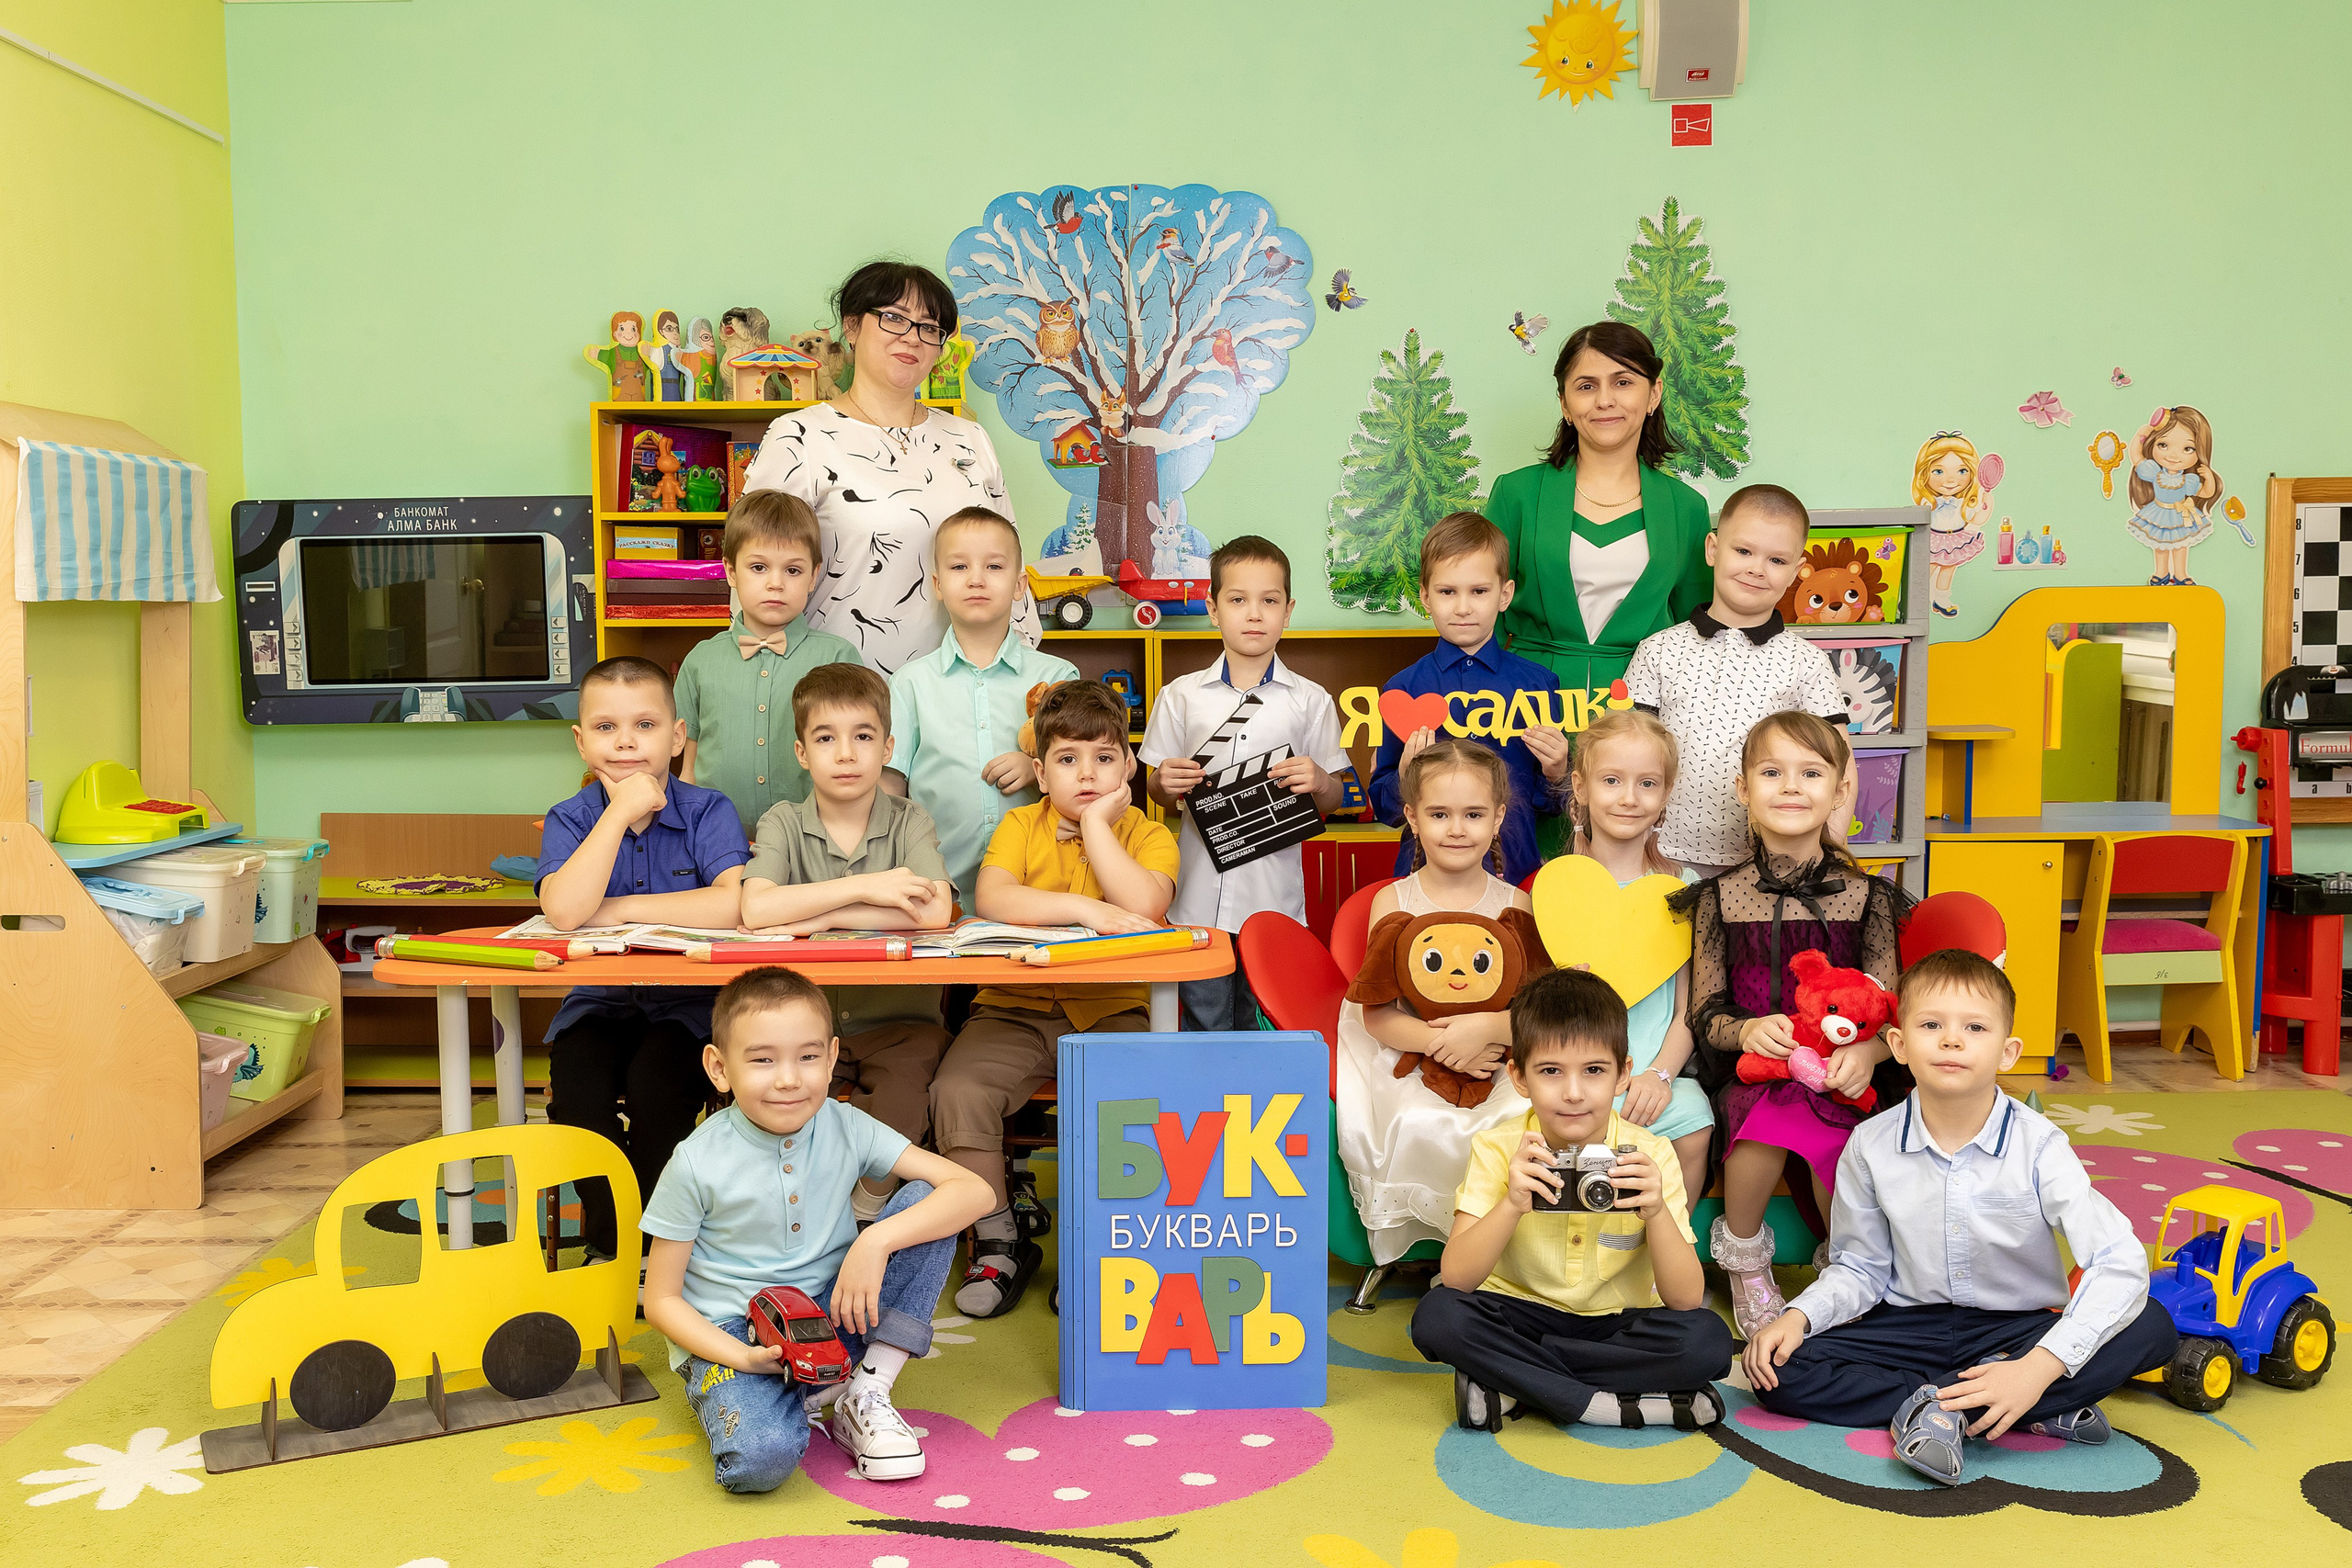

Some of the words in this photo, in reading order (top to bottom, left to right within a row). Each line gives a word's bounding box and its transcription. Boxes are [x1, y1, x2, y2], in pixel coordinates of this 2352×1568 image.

[394, 506, 449, 517] БАНКОМАТ
[387, 519, 422, 532] АЛМА
[425, 518, 458, 531] БАНК
[2295, 518, 2302, 530] 8
[618, 540, 650, 548] РАССКАЖИ
[652, 540, 675, 548] СКАЗКУ
[2295, 553, 2301, 566] 7
[2293, 587, 2301, 600] 6
[2292, 621, 2300, 633] 5
[2291, 656, 2298, 666] 4
[1339, 686, 1383, 749] Я
[1239, 787, 1258, 799] TAKE
[2312, 784, 2318, 795] a
[2346, 783, 2352, 795] b
[1195, 792, 1225, 807] PROD.NO.
[1272, 796, 1297, 811] SOUND
[1204, 800, 1227, 813] SCENE
[1208, 826, 1223, 836] DATE
[1212, 830, 1239, 844] PROD.CO.
[1216, 840, 1246, 854] DIRECTOR
[1220, 847, 1256, 864] CAMERAMAN
[1798, 1059, 1827, 1077] ЛЮБЛЮ
[1807, 1075, 1825, 1086] ОЧЕ
[1110, 1213, 1298, 1249] БУКВАРЬ
[1100, 1256, 1306, 1365] ВАРЬ
